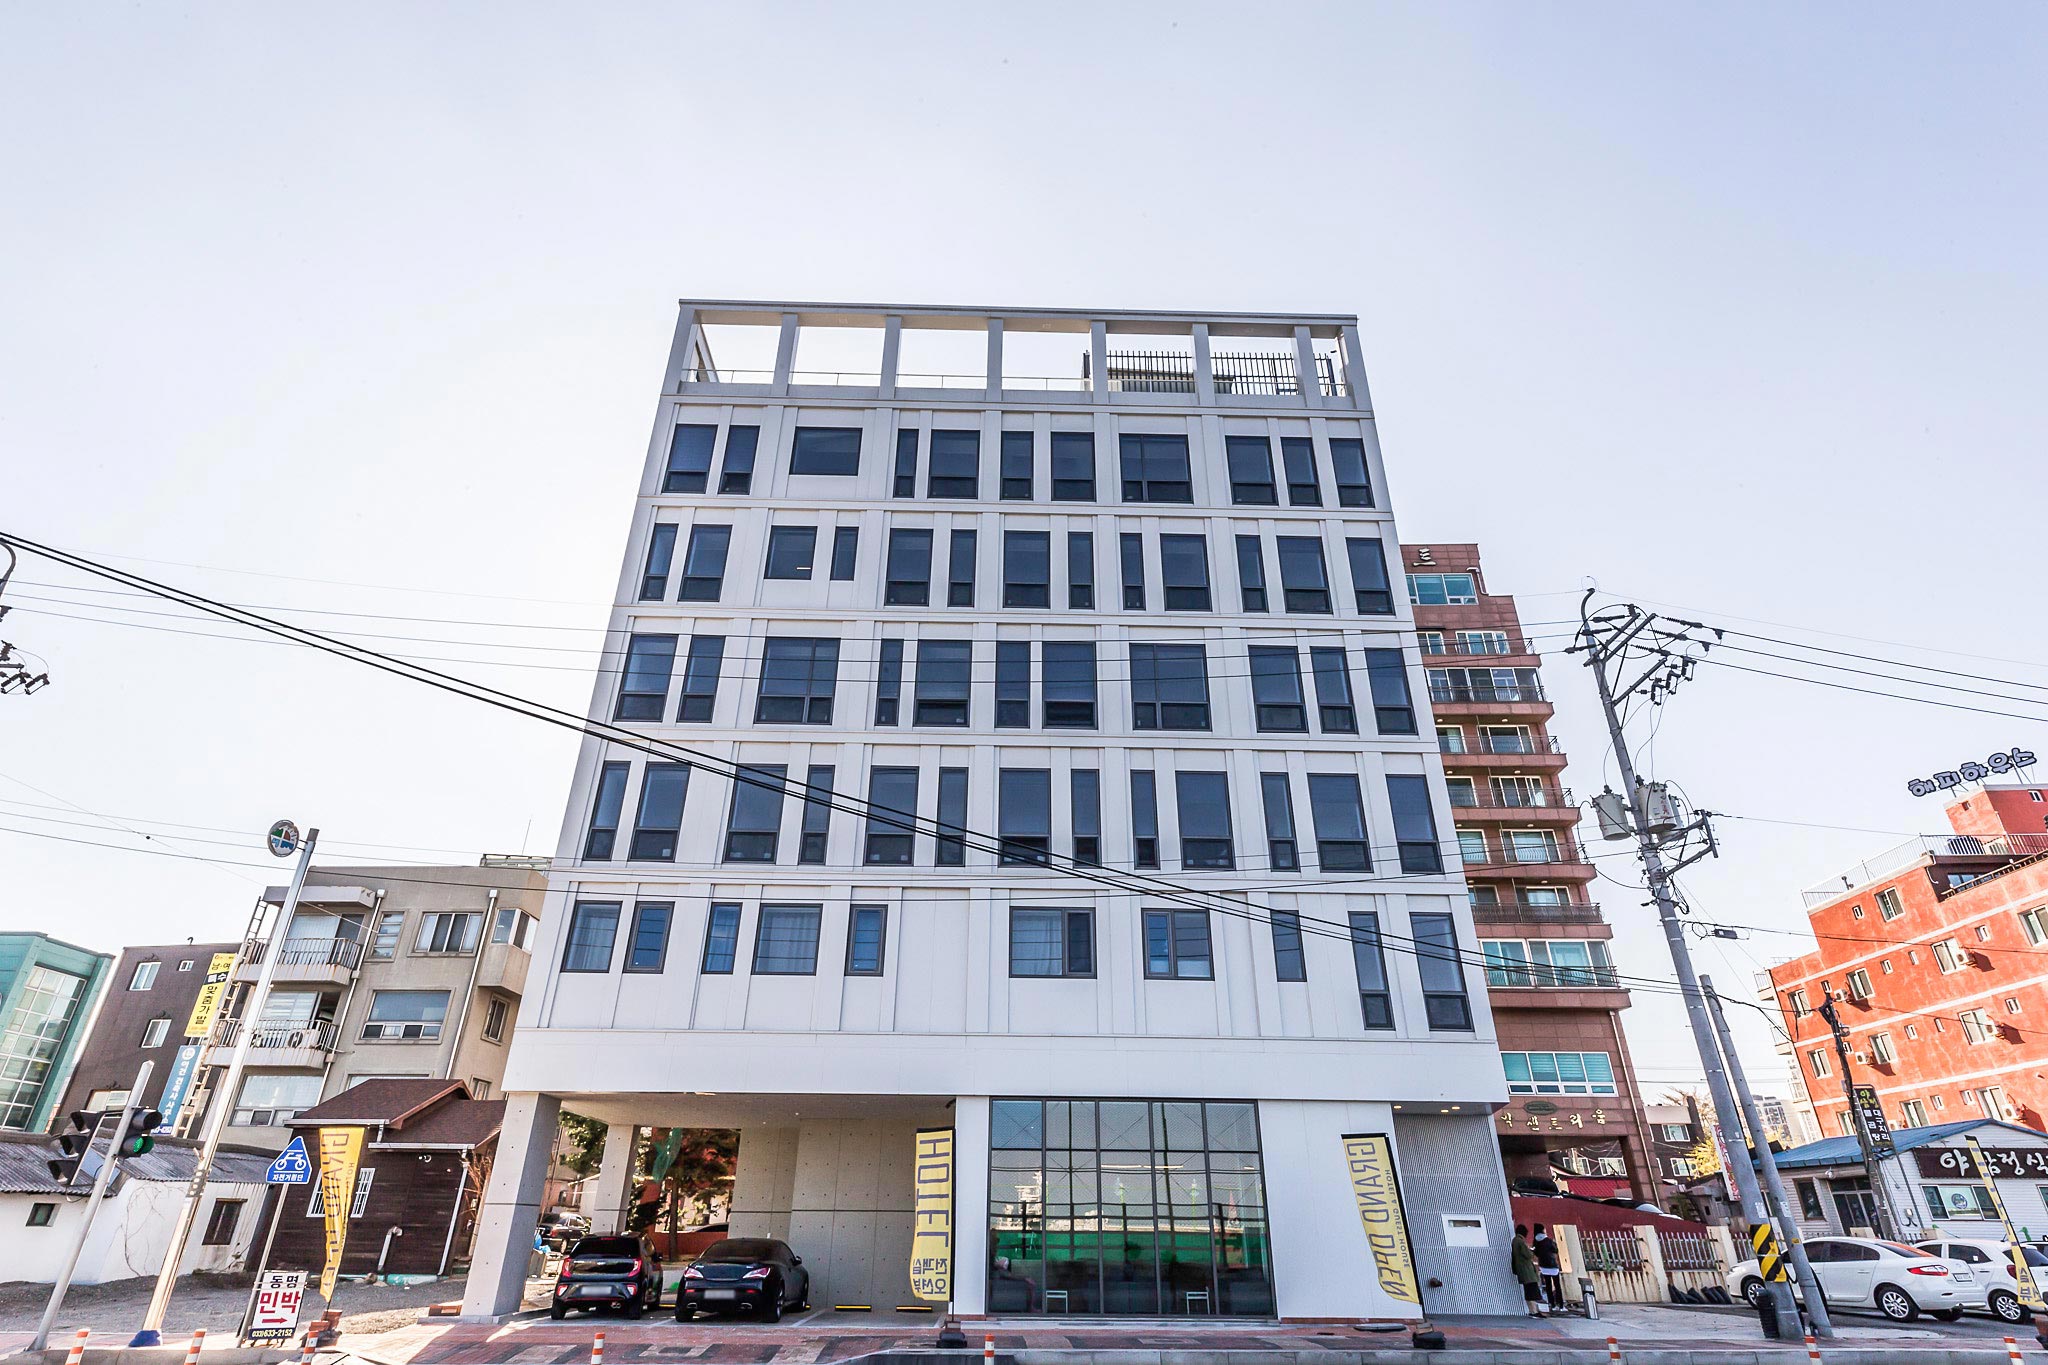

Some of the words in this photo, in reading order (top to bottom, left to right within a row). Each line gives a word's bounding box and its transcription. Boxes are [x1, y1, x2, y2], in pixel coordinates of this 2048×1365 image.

[1908, 747, 2037, 797] 해피하우스
[195, 985, 218, 1025] 맞춤가발
[1873, 1109, 1890, 1140] 대구지리
[270, 1275, 299, 1288] 동명
[260, 1291, 301, 1313] 민박
